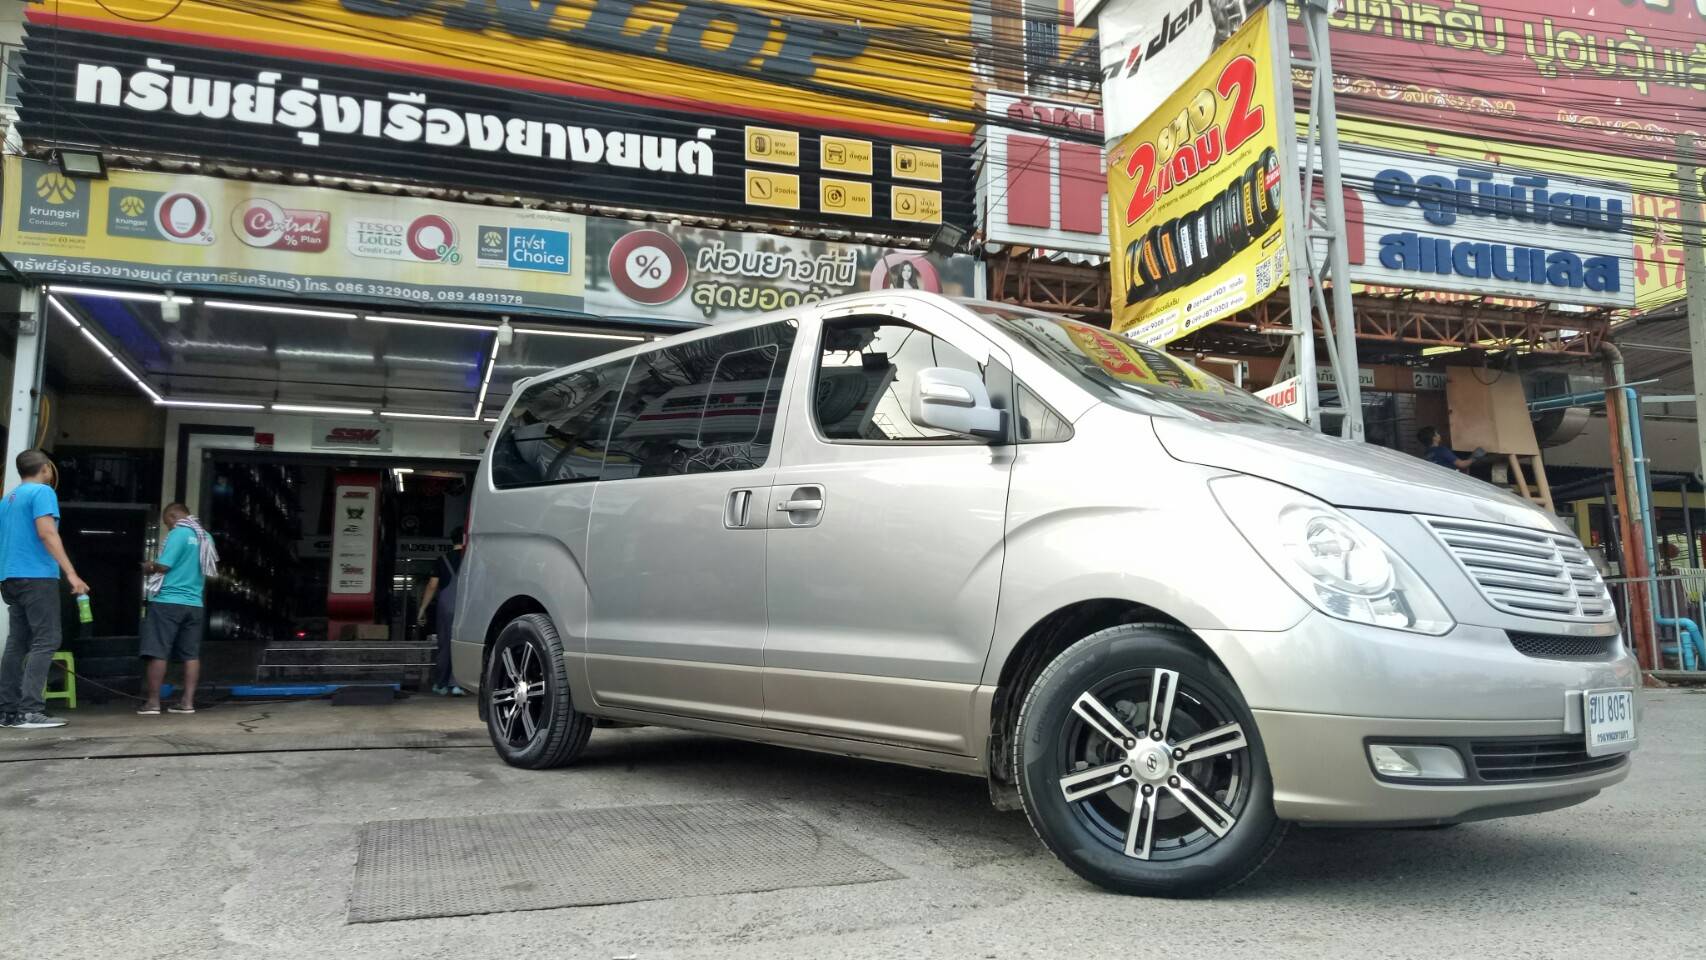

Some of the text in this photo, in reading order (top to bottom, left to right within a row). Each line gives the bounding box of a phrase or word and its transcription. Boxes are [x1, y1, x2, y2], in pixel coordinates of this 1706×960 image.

[75, 57, 717, 177] ทรัพย์รุ่งเรืองยางยนต์
[1126, 142, 1157, 227] 2
[1216, 55, 1264, 155] 2
[1373, 168, 1623, 233] อลูมิเนียม
[29, 218, 68, 227] Consumer
[30, 206, 80, 219] krungsri
[250, 212, 322, 234] Central
[357, 221, 403, 232] TESCO
[300, 235, 321, 244] Plan
[358, 233, 402, 247] Lotus
[512, 249, 565, 266] Choice
[698, 246, 858, 286] ผ่อนยาวที่นี่
[1378, 232, 1621, 293] สแตนเลส
[14, 258, 171, 282] ทรัพย์รุ่งเรืองยางยนต์
[335, 282, 364, 293] 086
[368, 284, 434, 301] 3329008,
[437, 291, 464, 301] 089
[468, 292, 523, 304] 4891378
[1415, 374, 1423, 387] 2
[1607, 694, 1632, 722] 8051
